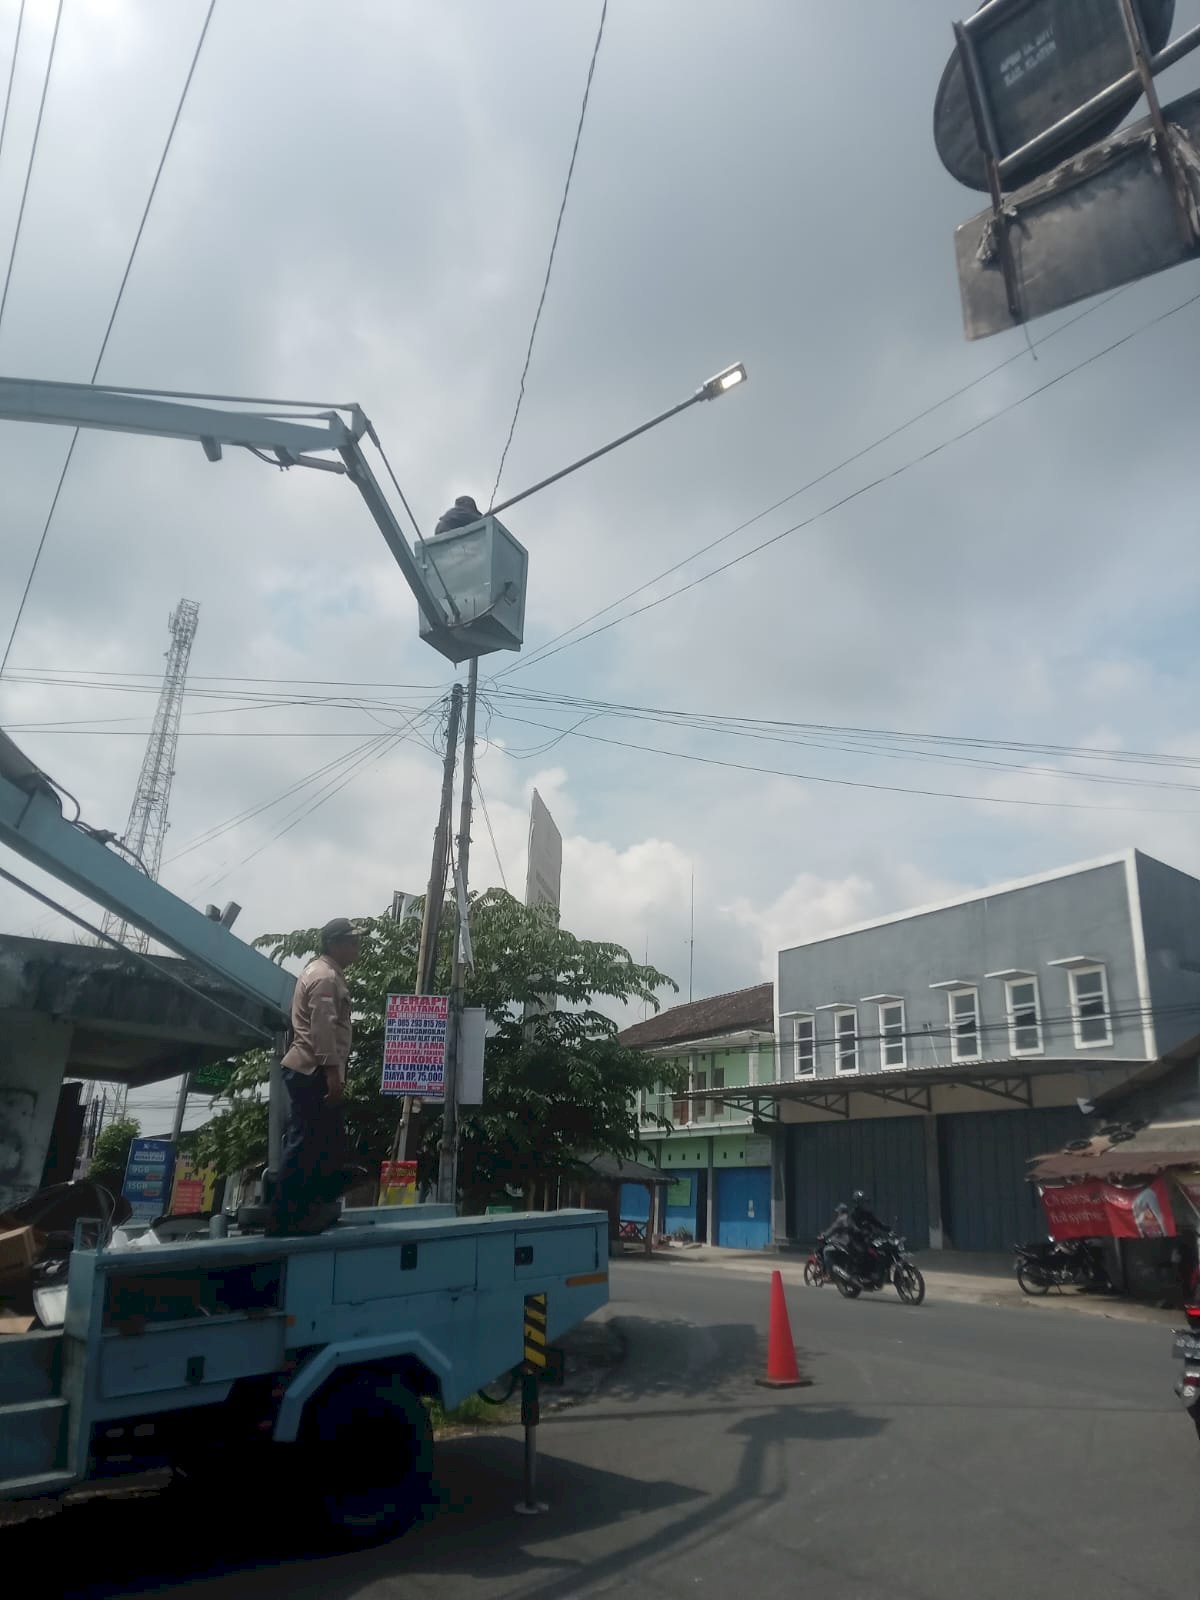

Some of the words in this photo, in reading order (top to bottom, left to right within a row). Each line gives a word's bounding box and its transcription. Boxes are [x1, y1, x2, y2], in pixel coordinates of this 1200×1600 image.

[391, 996, 447, 1005] TERAPI
[389, 1005, 447, 1013] KEJANTANAN
[411, 1019, 423, 1028] 293
[386, 1027, 446, 1035] MENGENCANGKAN
[430, 1035, 445, 1043] VITAL
[387, 1041, 416, 1049] TAHAN
[418, 1042, 445, 1050] LAMA
[385, 1055, 444, 1064] VARIKOKEL
[384, 1063, 444, 1072] KETURUNAN
[384, 1071, 405, 1081] BIAYA
[406, 1071, 416, 1081] RP.
[417, 1071, 443, 1082] 75.000
[383, 1081, 417, 1089] DIJAMIN
